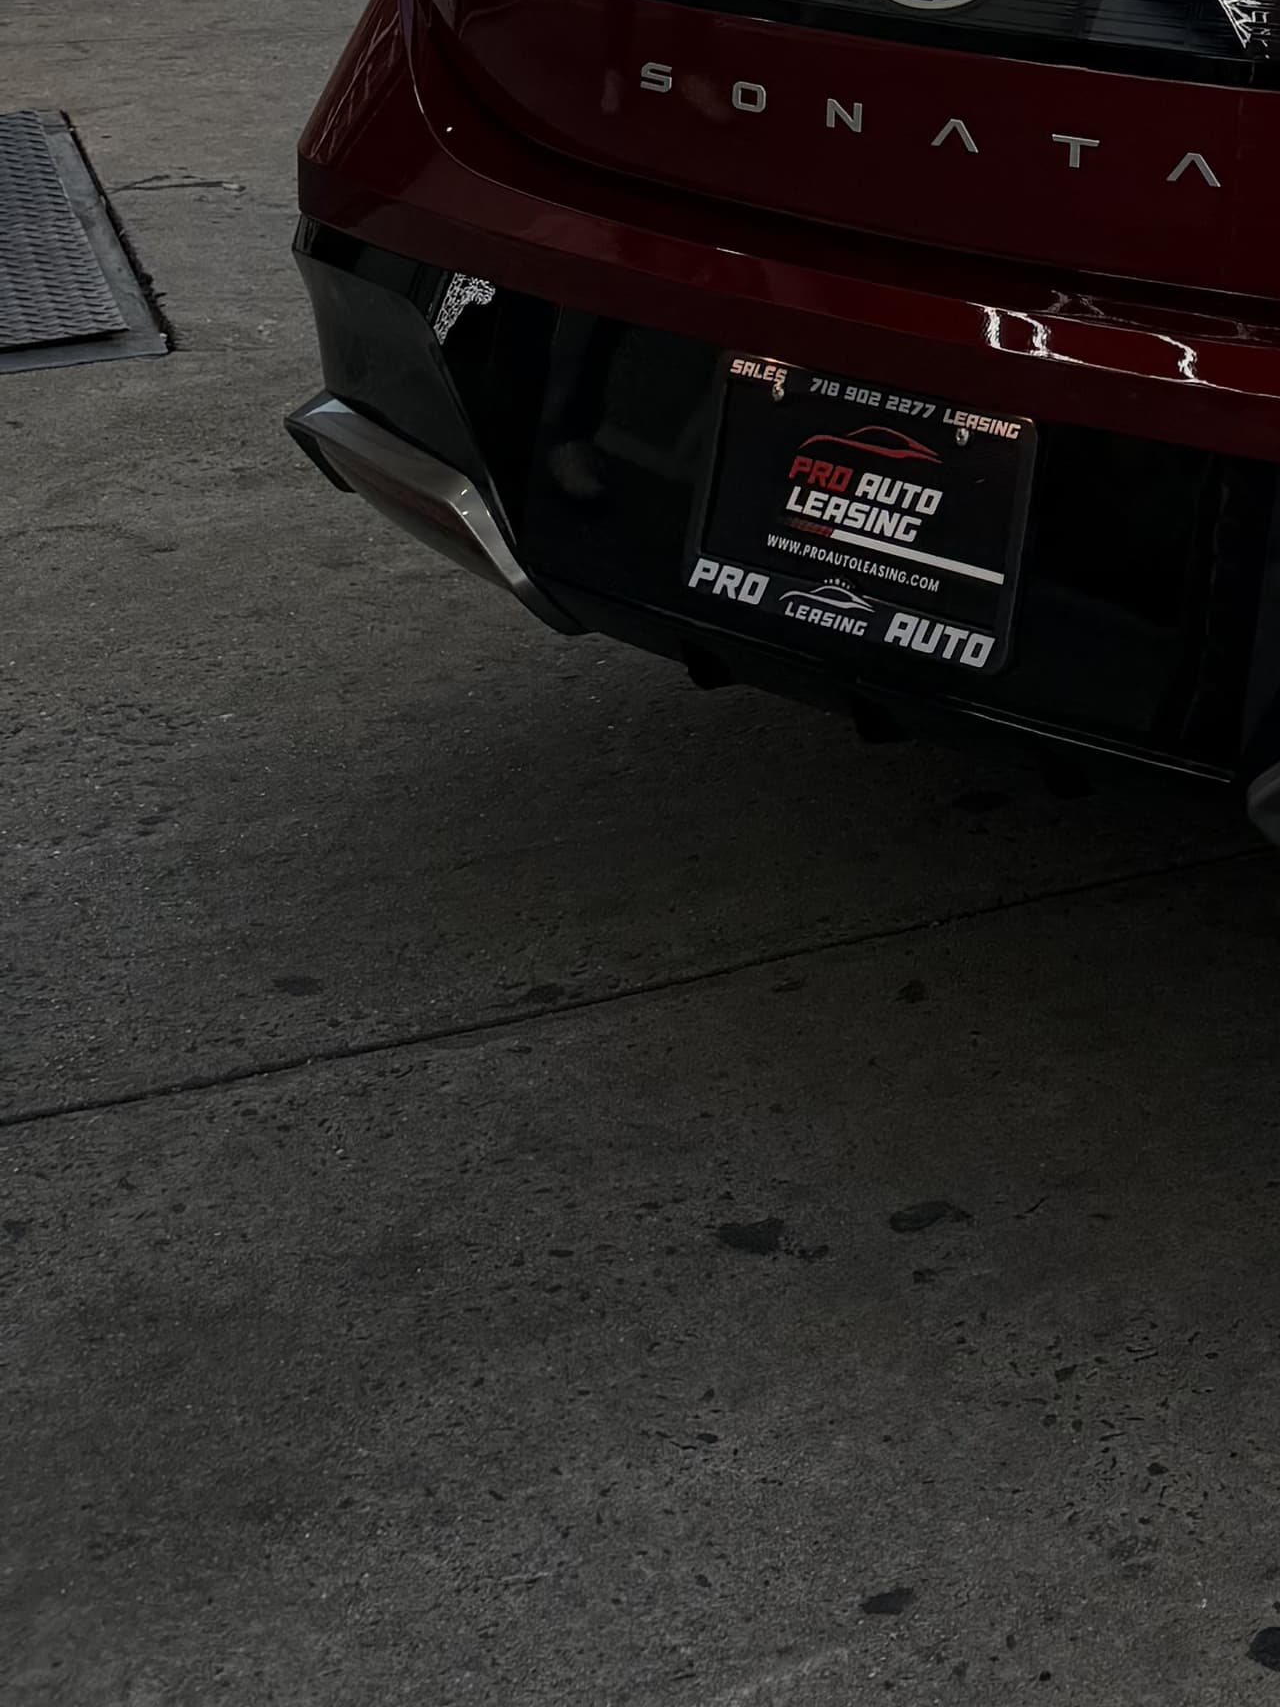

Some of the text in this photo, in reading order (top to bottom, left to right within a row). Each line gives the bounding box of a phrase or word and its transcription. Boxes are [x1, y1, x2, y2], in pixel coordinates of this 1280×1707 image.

[640, 61, 1221, 188] SONATA
[730, 358, 1022, 440] SALES 718 902 2277 LEASING
[785, 485, 922, 543] LEASING
[788, 455, 943, 516] PRO AUTO
[766, 533, 941, 593] WWW.PROAUTOLEASING.COM
[687, 557, 996, 669] PRO LEASING AUTO
